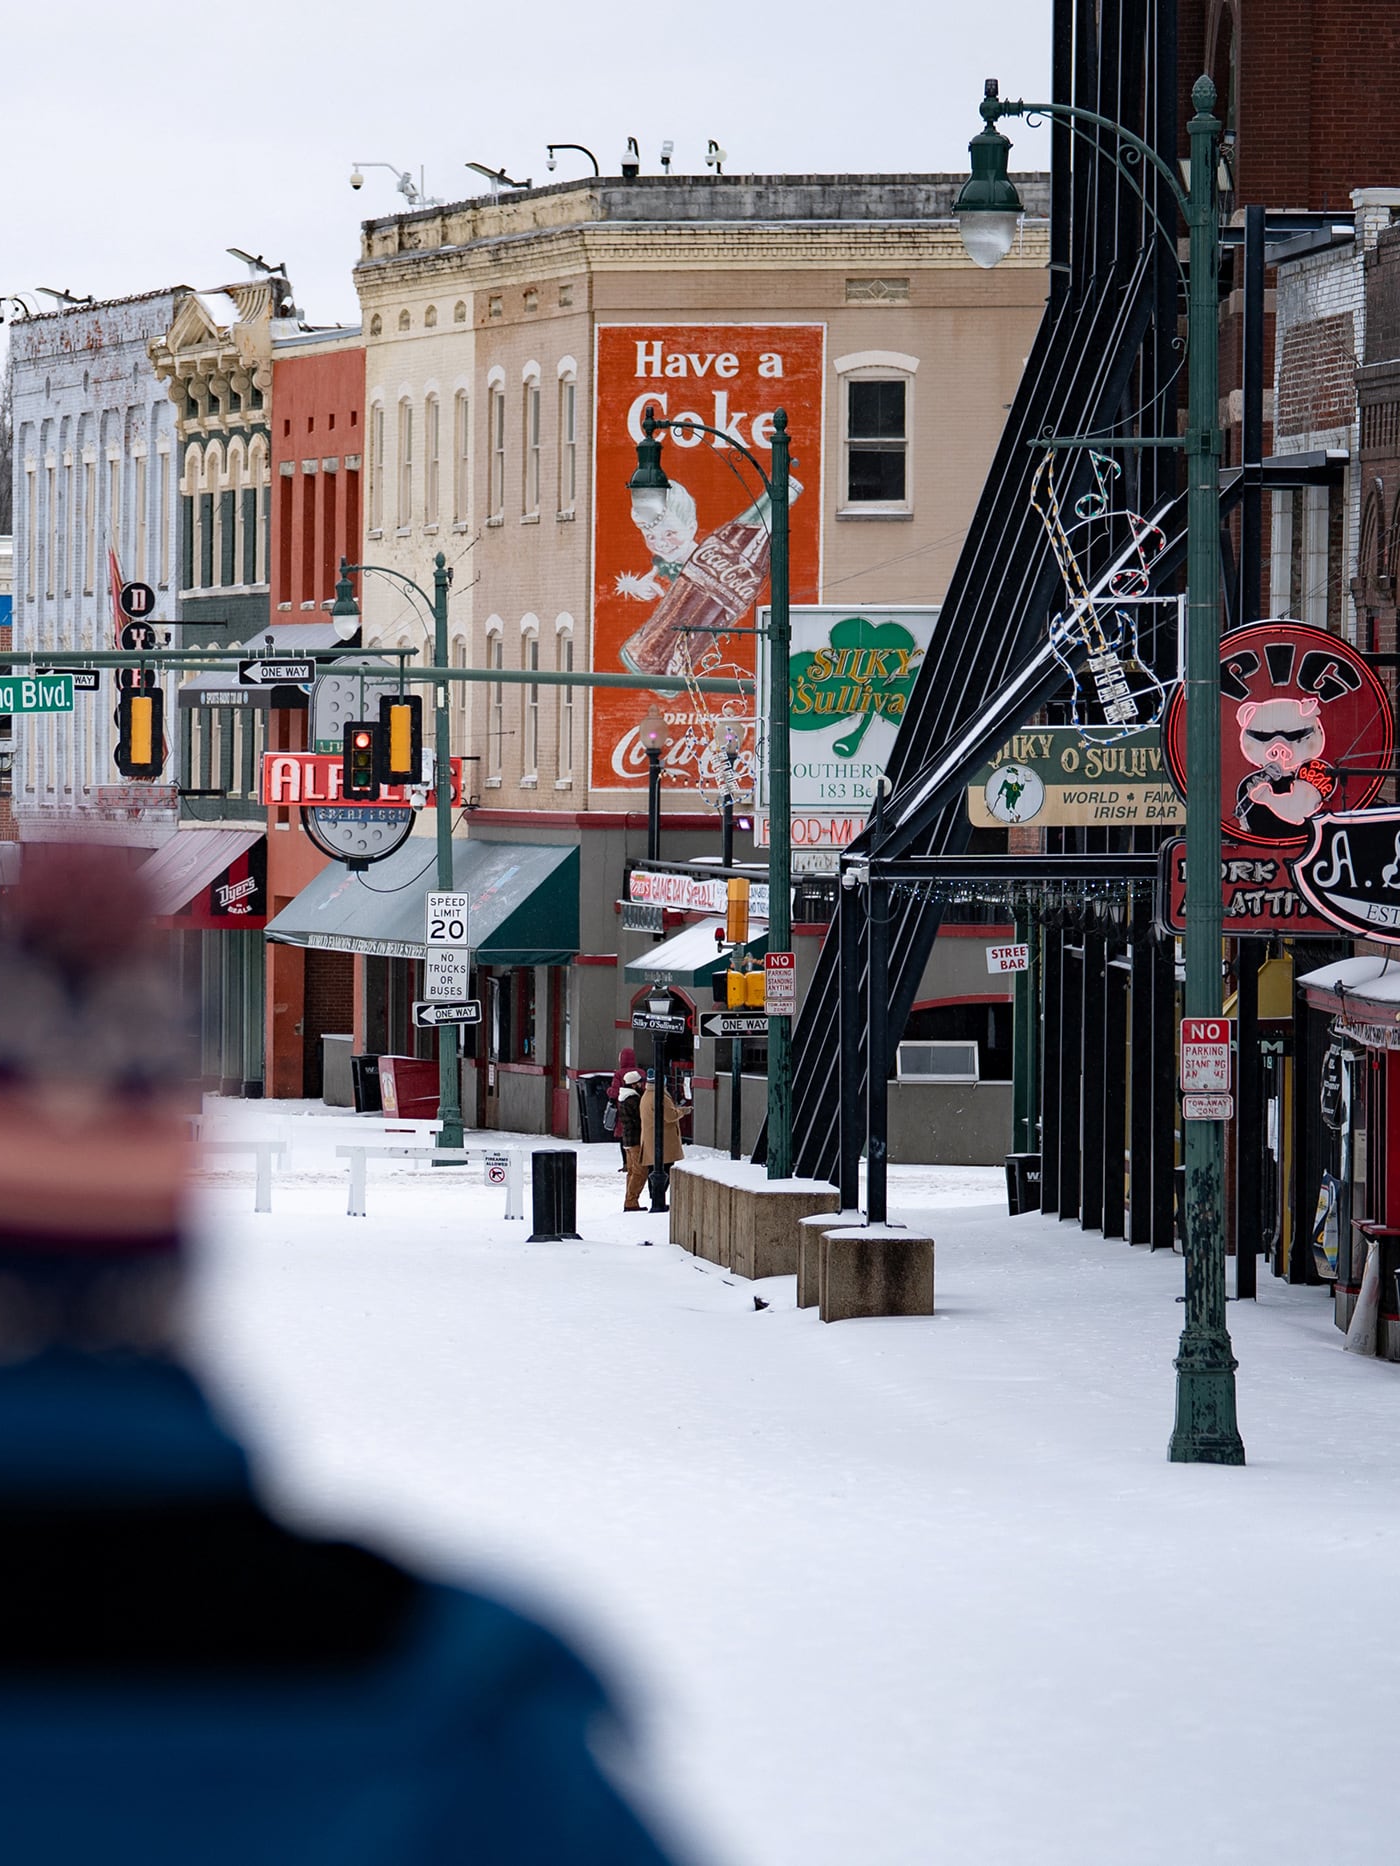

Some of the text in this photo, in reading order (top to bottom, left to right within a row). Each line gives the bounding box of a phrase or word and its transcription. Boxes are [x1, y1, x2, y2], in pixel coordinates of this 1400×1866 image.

[634, 341, 784, 379] Have a
[627, 391, 773, 449] Coke
[806, 648, 925, 684] SILKY
[261, 667, 307, 677] ONE WAY
[1220, 643, 1363, 703] PIG
[75, 676, 93, 685] WAY
[21, 679, 72, 709] Blvd.
[792, 763, 885, 779] OUTHERN
[821, 783, 847, 798] 183
[1063, 792, 1120, 804] WORLD
[1094, 806, 1179, 819] IRISH BAR
[763, 818, 864, 845] FOD-MU
[430, 897, 466, 906] SPEED
[434, 909, 461, 918] LIMIT
[430, 920, 464, 939] 20
[441, 953, 454, 963] NO
[771, 956, 790, 967] NO
[429, 964, 466, 974] TRUCKS
[1000, 959, 1025, 970] BAR
[440, 976, 453, 985] OR
[430, 986, 463, 996] BUSES
[435, 1008, 474, 1019] ONE WAY
[722, 1020, 768, 1030] ONE WAY
[1190, 1024, 1221, 1039] NO
[1185, 1047, 1224, 1056] PARKING
[1184, 1060, 1226, 1070] STANNG
[1185, 1070, 1226, 1080] ANME
[1026, 1171, 1041, 1180] W
